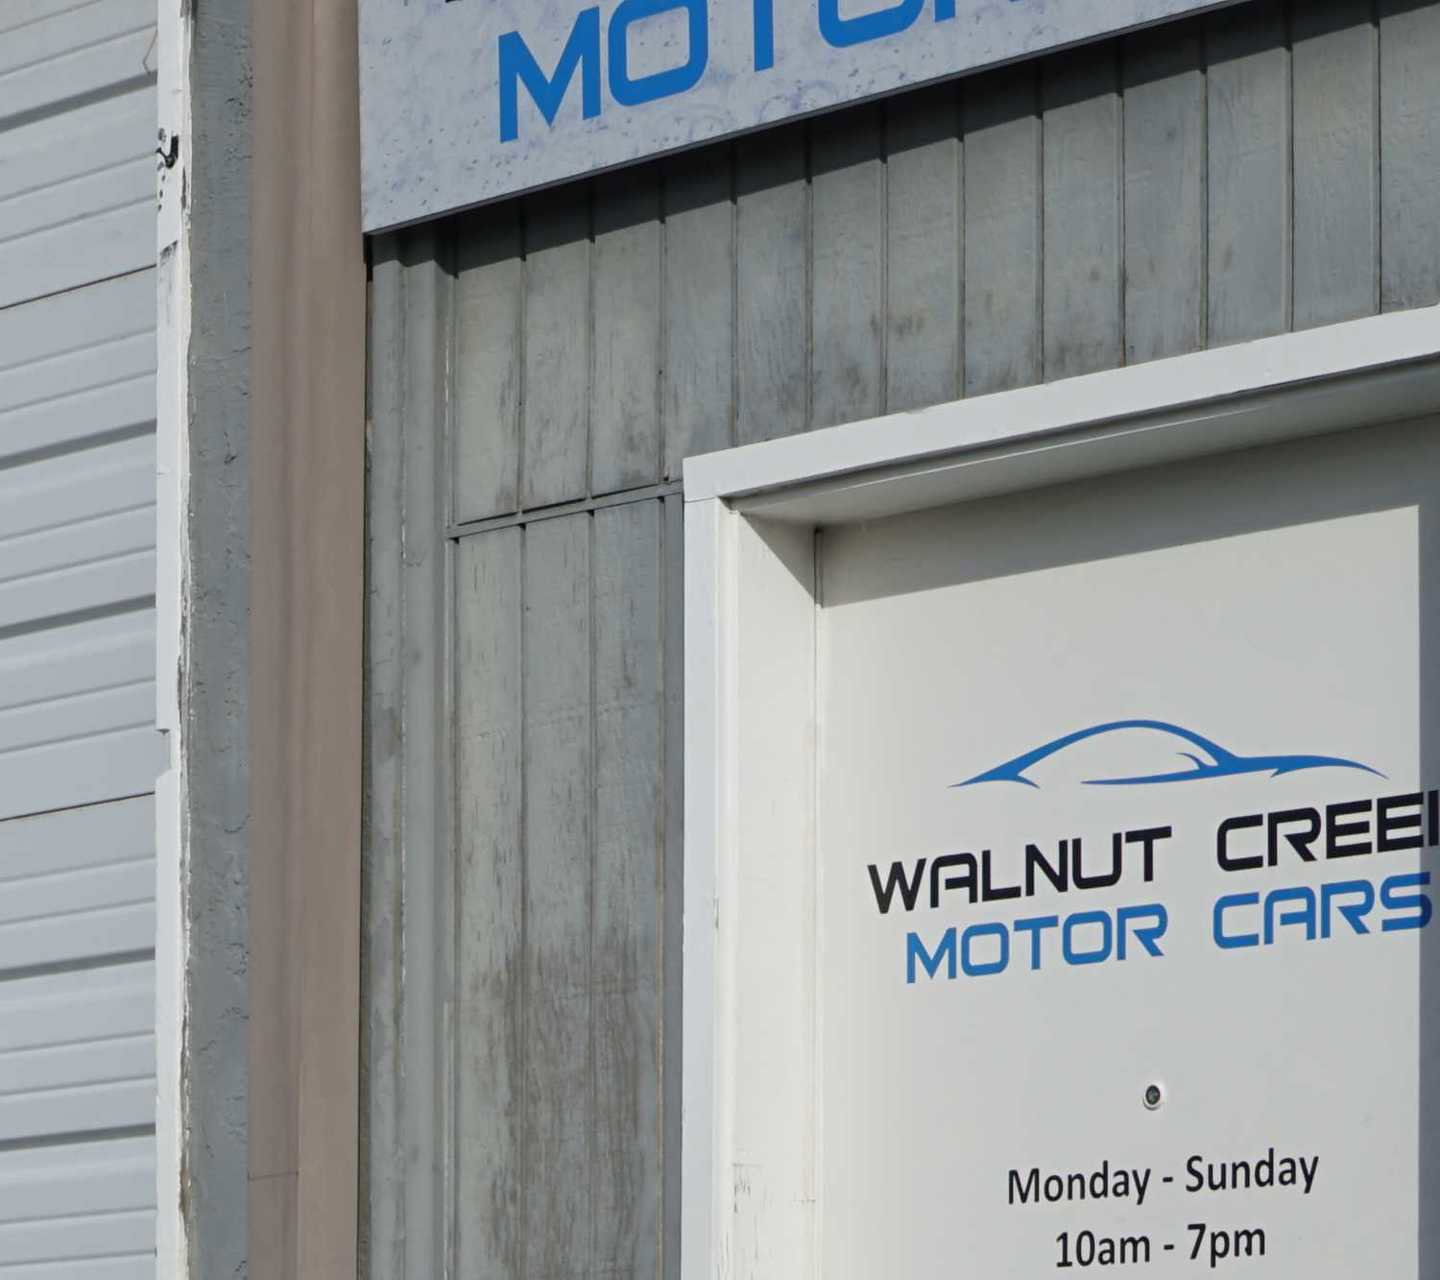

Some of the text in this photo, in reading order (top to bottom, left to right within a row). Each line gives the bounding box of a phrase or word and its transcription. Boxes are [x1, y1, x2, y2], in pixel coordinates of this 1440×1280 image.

[867, 825, 1172, 915] WALNUT
[906, 871, 1432, 984] MOTOR CARS
[1007, 1147, 1319, 1206] Monday - Sunday
[1055, 1223, 1267, 1269] 10am - 7pm
